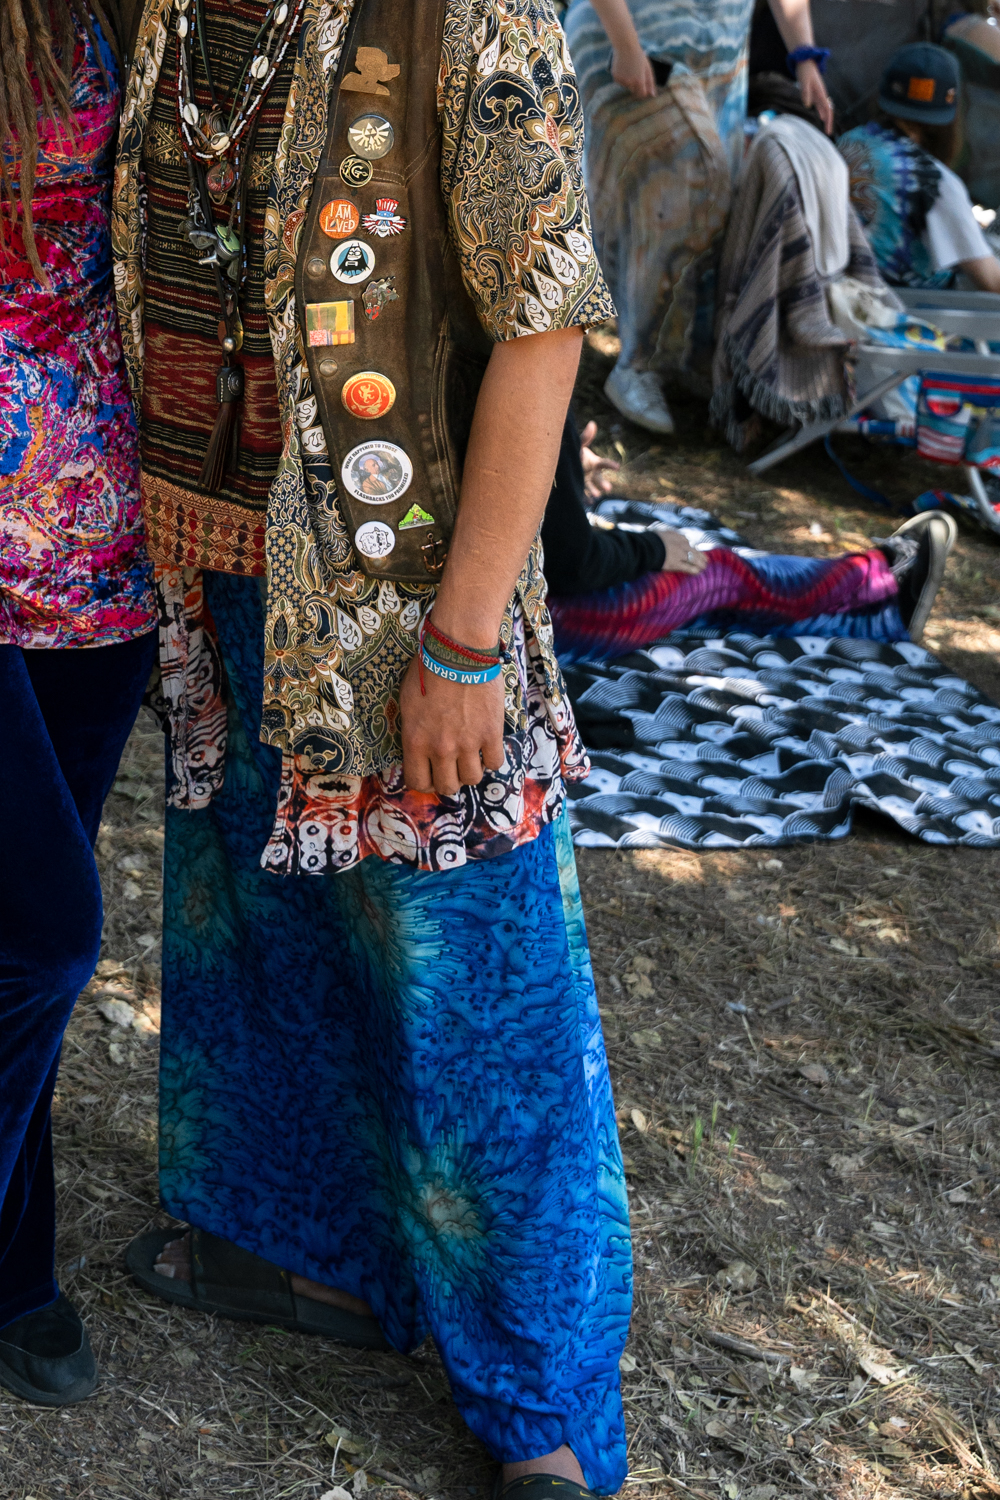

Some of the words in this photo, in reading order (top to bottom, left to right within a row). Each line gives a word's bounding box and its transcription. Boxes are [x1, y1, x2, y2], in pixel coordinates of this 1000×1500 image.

[330, 202, 334, 217] I
[335, 204, 352, 220] AM
[324, 215, 356, 233] LOVED
[344, 455, 354, 469] WHAT
[351, 444, 374, 458] HAPPENED
[382, 444, 398, 453] THOSE
[353, 489, 386, 502] FLASHBACKS
[385, 493, 395, 501] YOU
[394, 472, 409, 496] PROMISED
[422, 653, 458, 681] GRATE
[461, 673, 482, 684] AM
[483, 672, 488, 682] I
